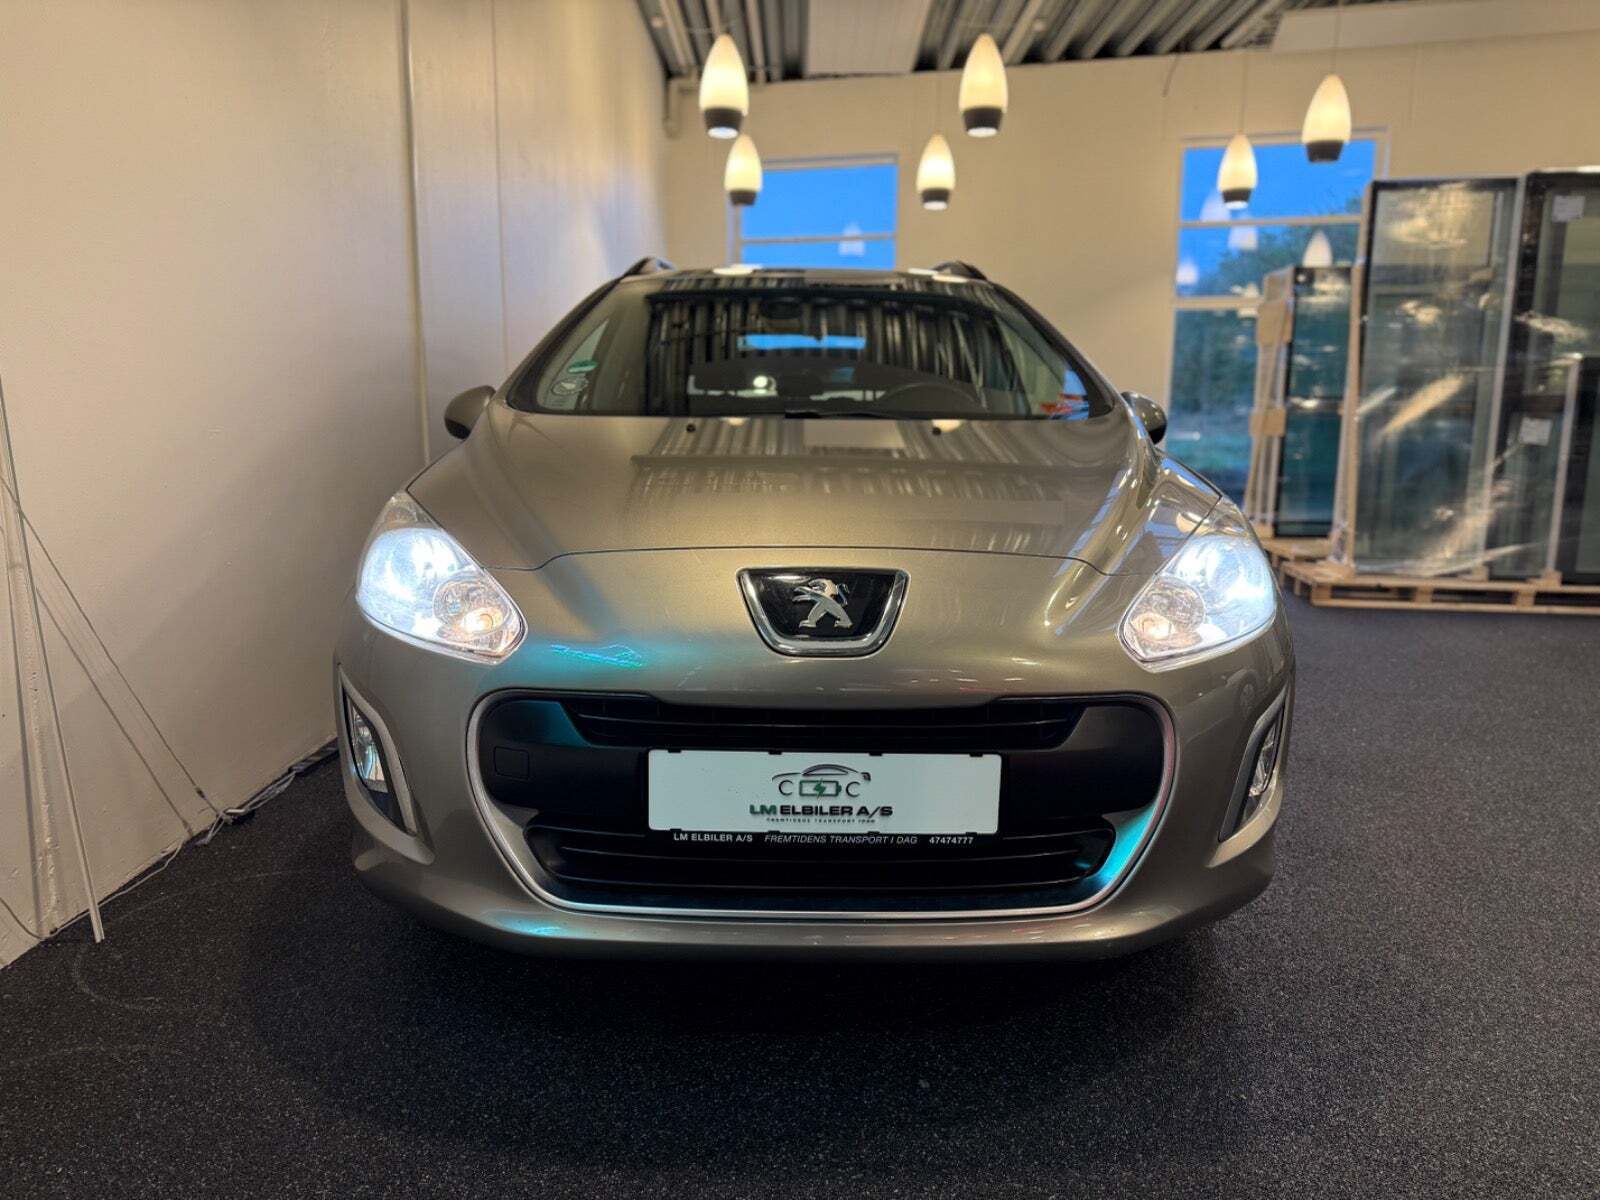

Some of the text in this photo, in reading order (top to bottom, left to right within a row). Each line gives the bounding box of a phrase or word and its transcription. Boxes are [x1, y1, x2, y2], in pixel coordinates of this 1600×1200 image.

[749, 804, 893, 818] LM ELBILER A/S
[673, 832, 688, 841] LM
[691, 833, 733, 842] ELBILER
[736, 834, 753, 842] A/S
[764, 835, 827, 843] FREMTIDENS
[829, 836, 888, 844] TRANSPORT
[896, 836, 917, 844] DAG
[929, 836, 974, 844] 47474777
